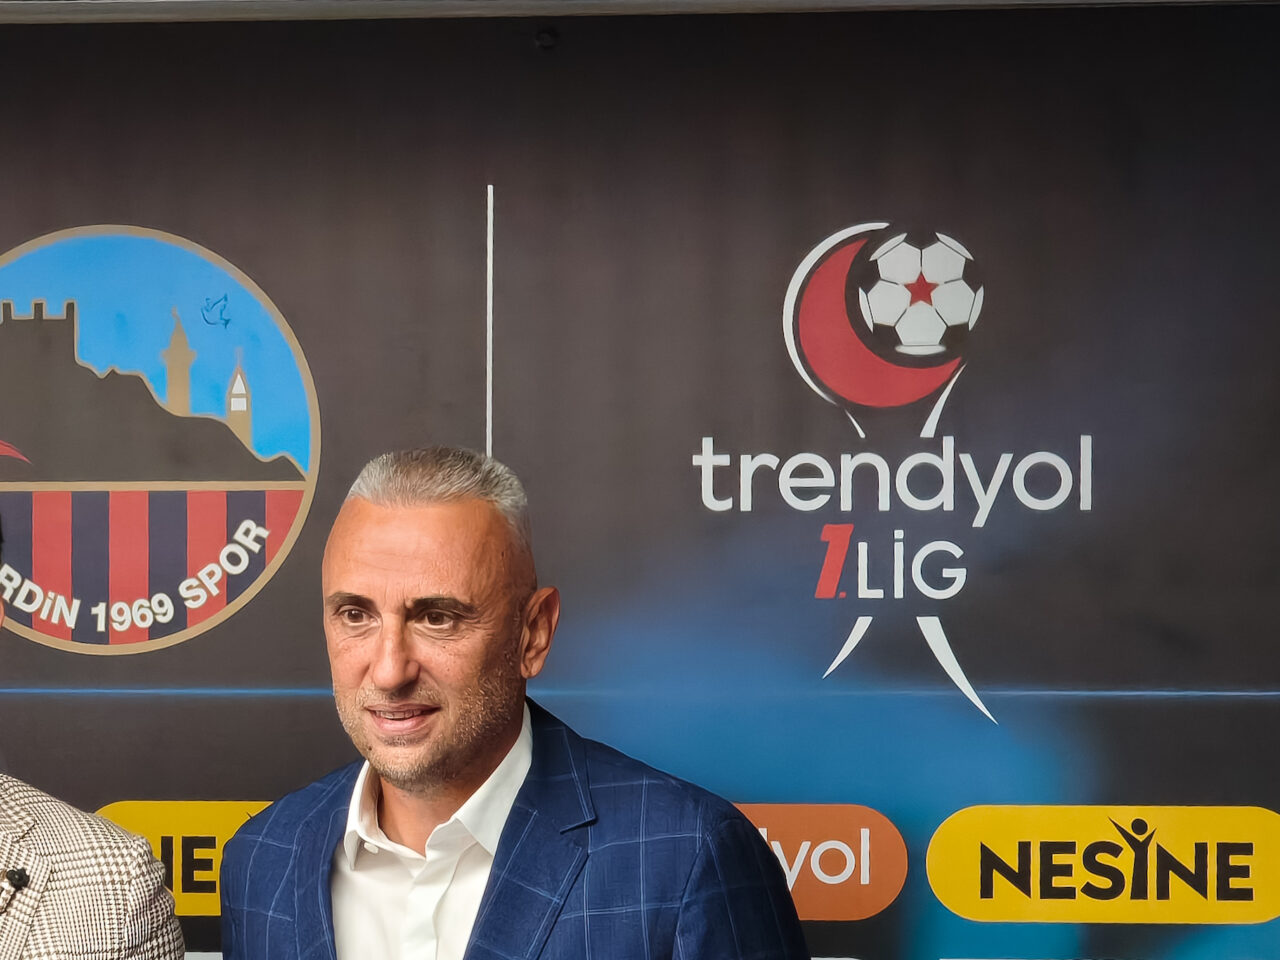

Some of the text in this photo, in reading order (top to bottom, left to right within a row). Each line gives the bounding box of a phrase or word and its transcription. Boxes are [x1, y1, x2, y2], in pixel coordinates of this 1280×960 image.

[692, 435, 1092, 528] trendyol
[91, 593, 175, 633] 1969
[178, 518, 272, 609] SPOR
